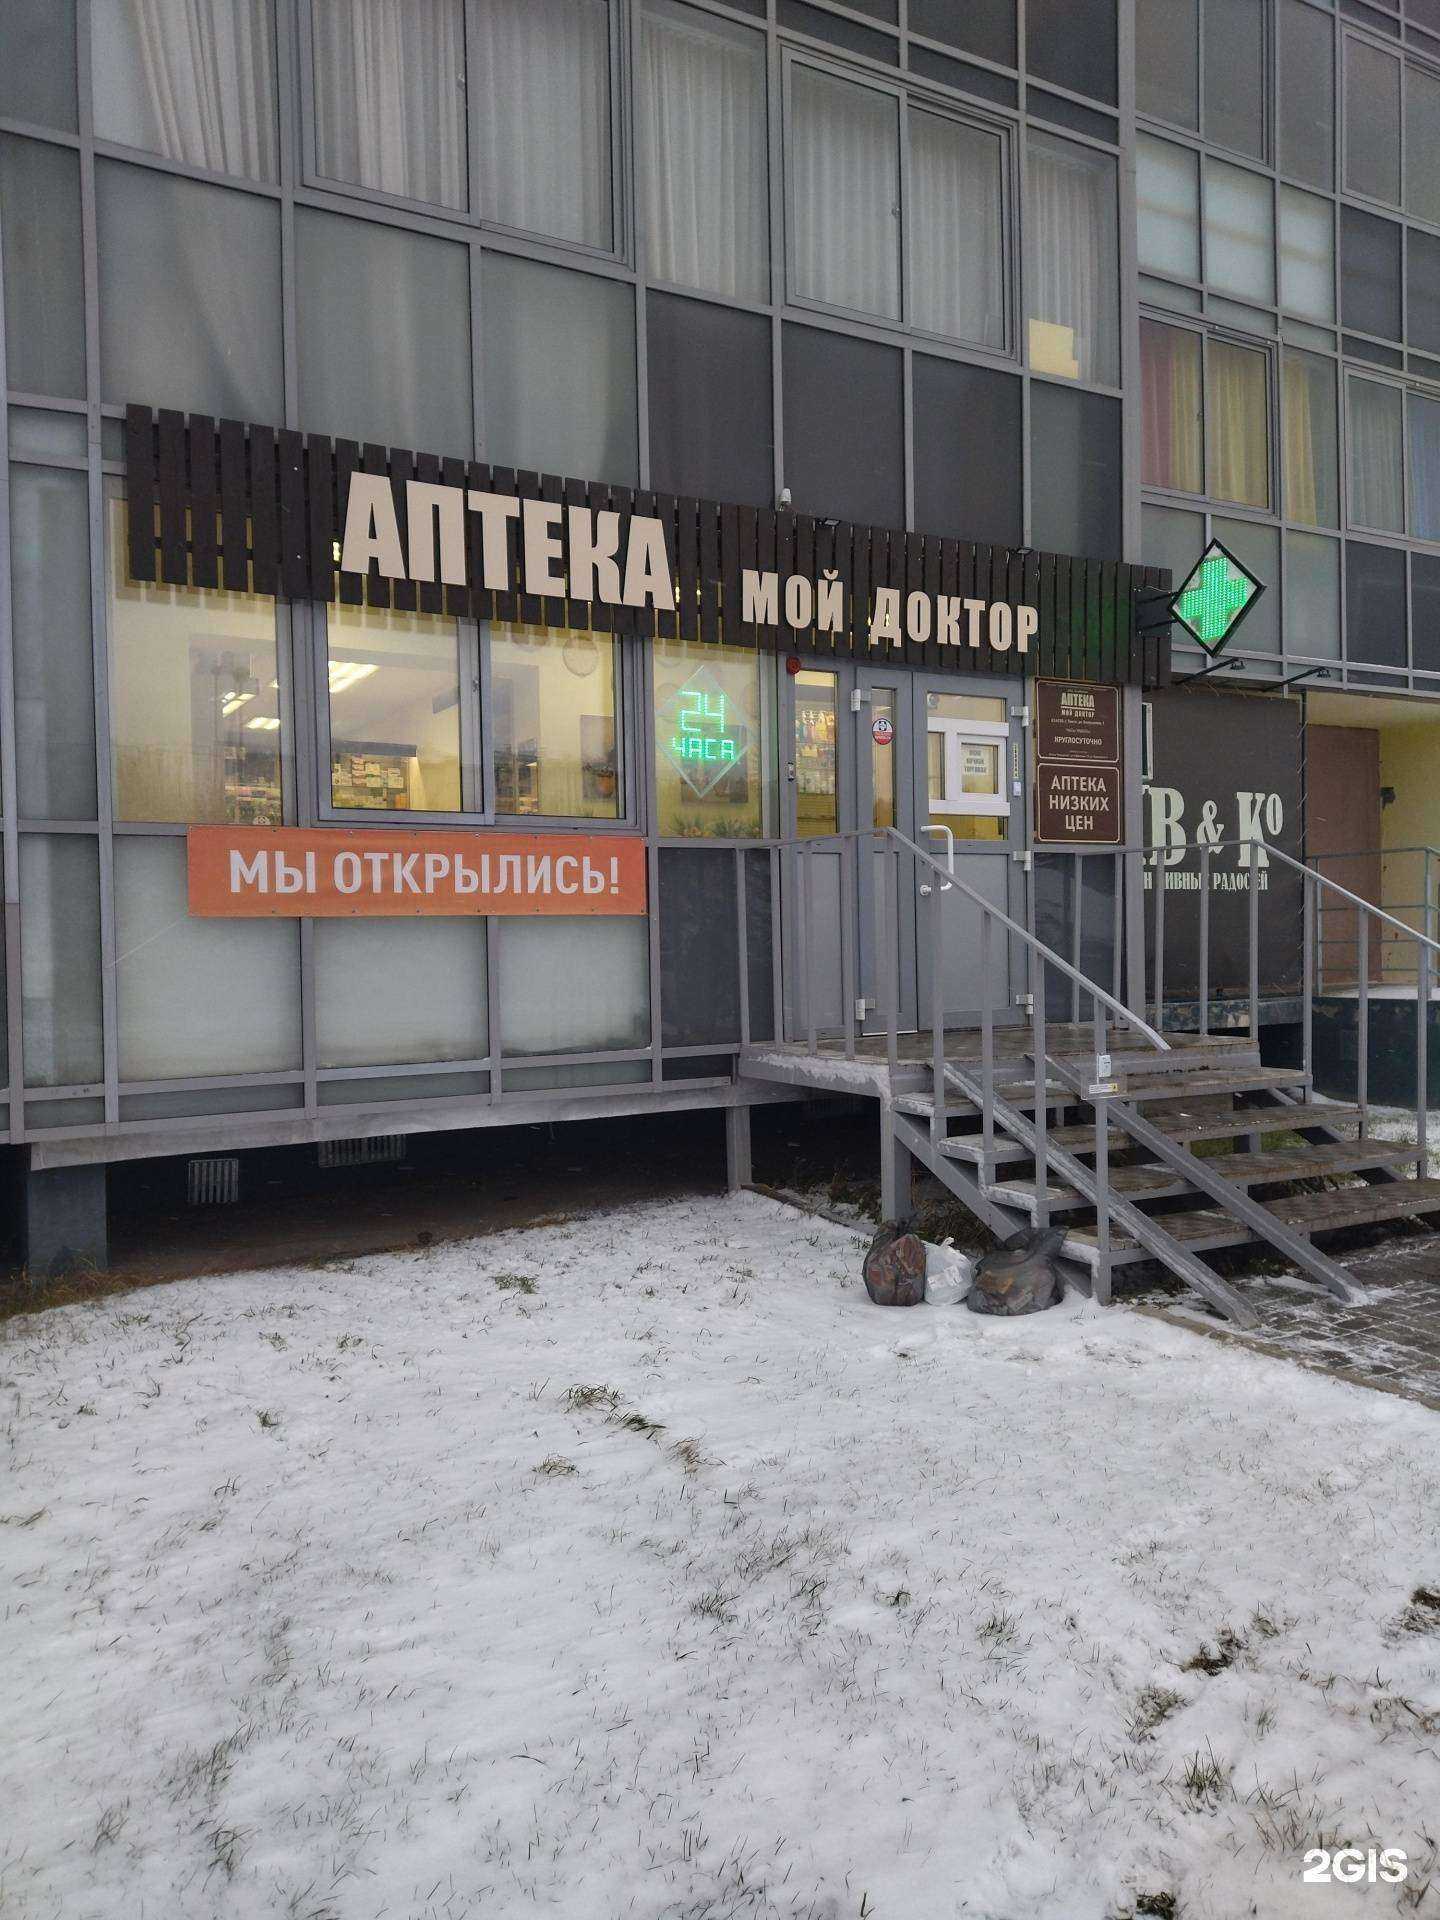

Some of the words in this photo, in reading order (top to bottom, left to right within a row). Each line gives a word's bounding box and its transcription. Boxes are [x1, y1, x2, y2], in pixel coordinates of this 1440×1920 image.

[341, 471, 675, 610] АПТЕКА
[742, 568, 844, 633] МОЙ
[870, 586, 1039, 653] ДОКТОР
[1061, 692, 1095, 708] АПТЕКА
[680, 690, 725, 733] 24
[672, 737, 734, 760] ЧАСА
[1054, 736, 1103, 746] КРУГЛОСУТОЧНО
[1051, 775, 1107, 792] АПТЕКА
[1049, 794, 1110, 811] НИЗКИХ
[1065, 815, 1094, 832] ЦЕН
[229, 850, 316, 893] МЫ
[333, 851, 620, 895] ОТКРЫЛИСЬ!
